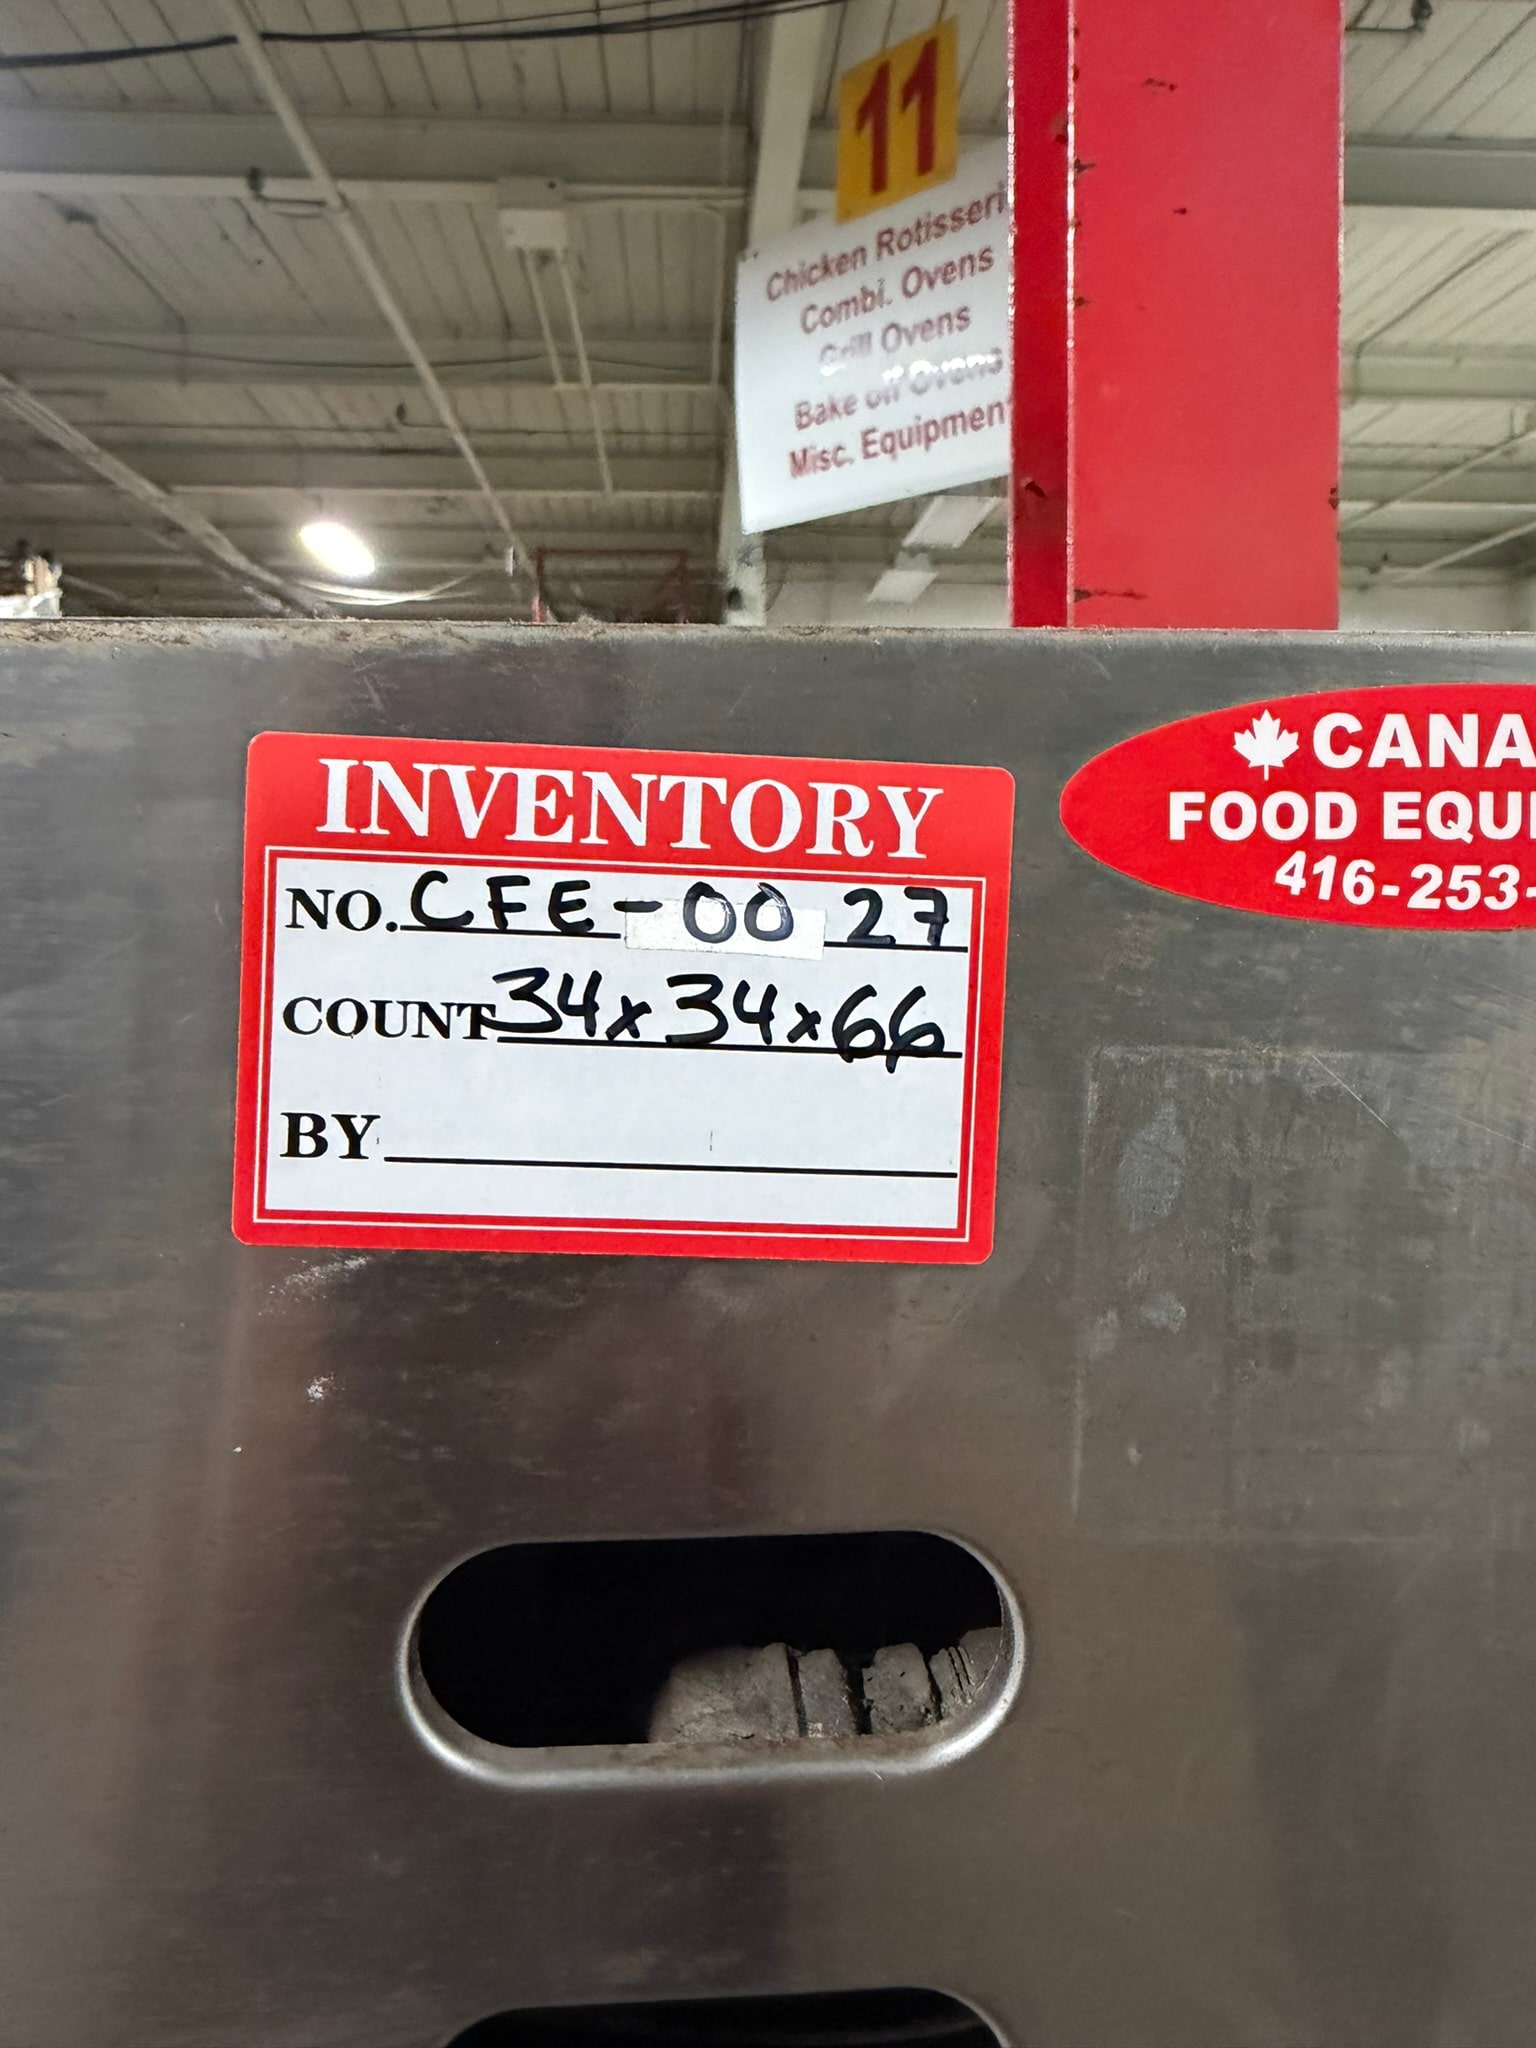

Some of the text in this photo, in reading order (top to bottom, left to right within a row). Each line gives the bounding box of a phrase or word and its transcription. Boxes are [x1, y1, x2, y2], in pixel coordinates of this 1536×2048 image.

[855, 36, 939, 195] 11
[766, 245, 868, 301] Chicken
[901, 245, 995, 298] Ovens
[881, 305, 971, 353] Ovens
[795, 393, 858, 430] Bake
[789, 399, 1010, 479] Misc. Equipmen
[1313, 712, 1536, 768] CANA
[316, 758, 944, 859] INVENTORY
[1169, 790, 1357, 841] FOOD
[285, 888, 398, 932] NO.
[283, 996, 496, 1040] COUNT
[279, 1112, 381, 1159] BY
